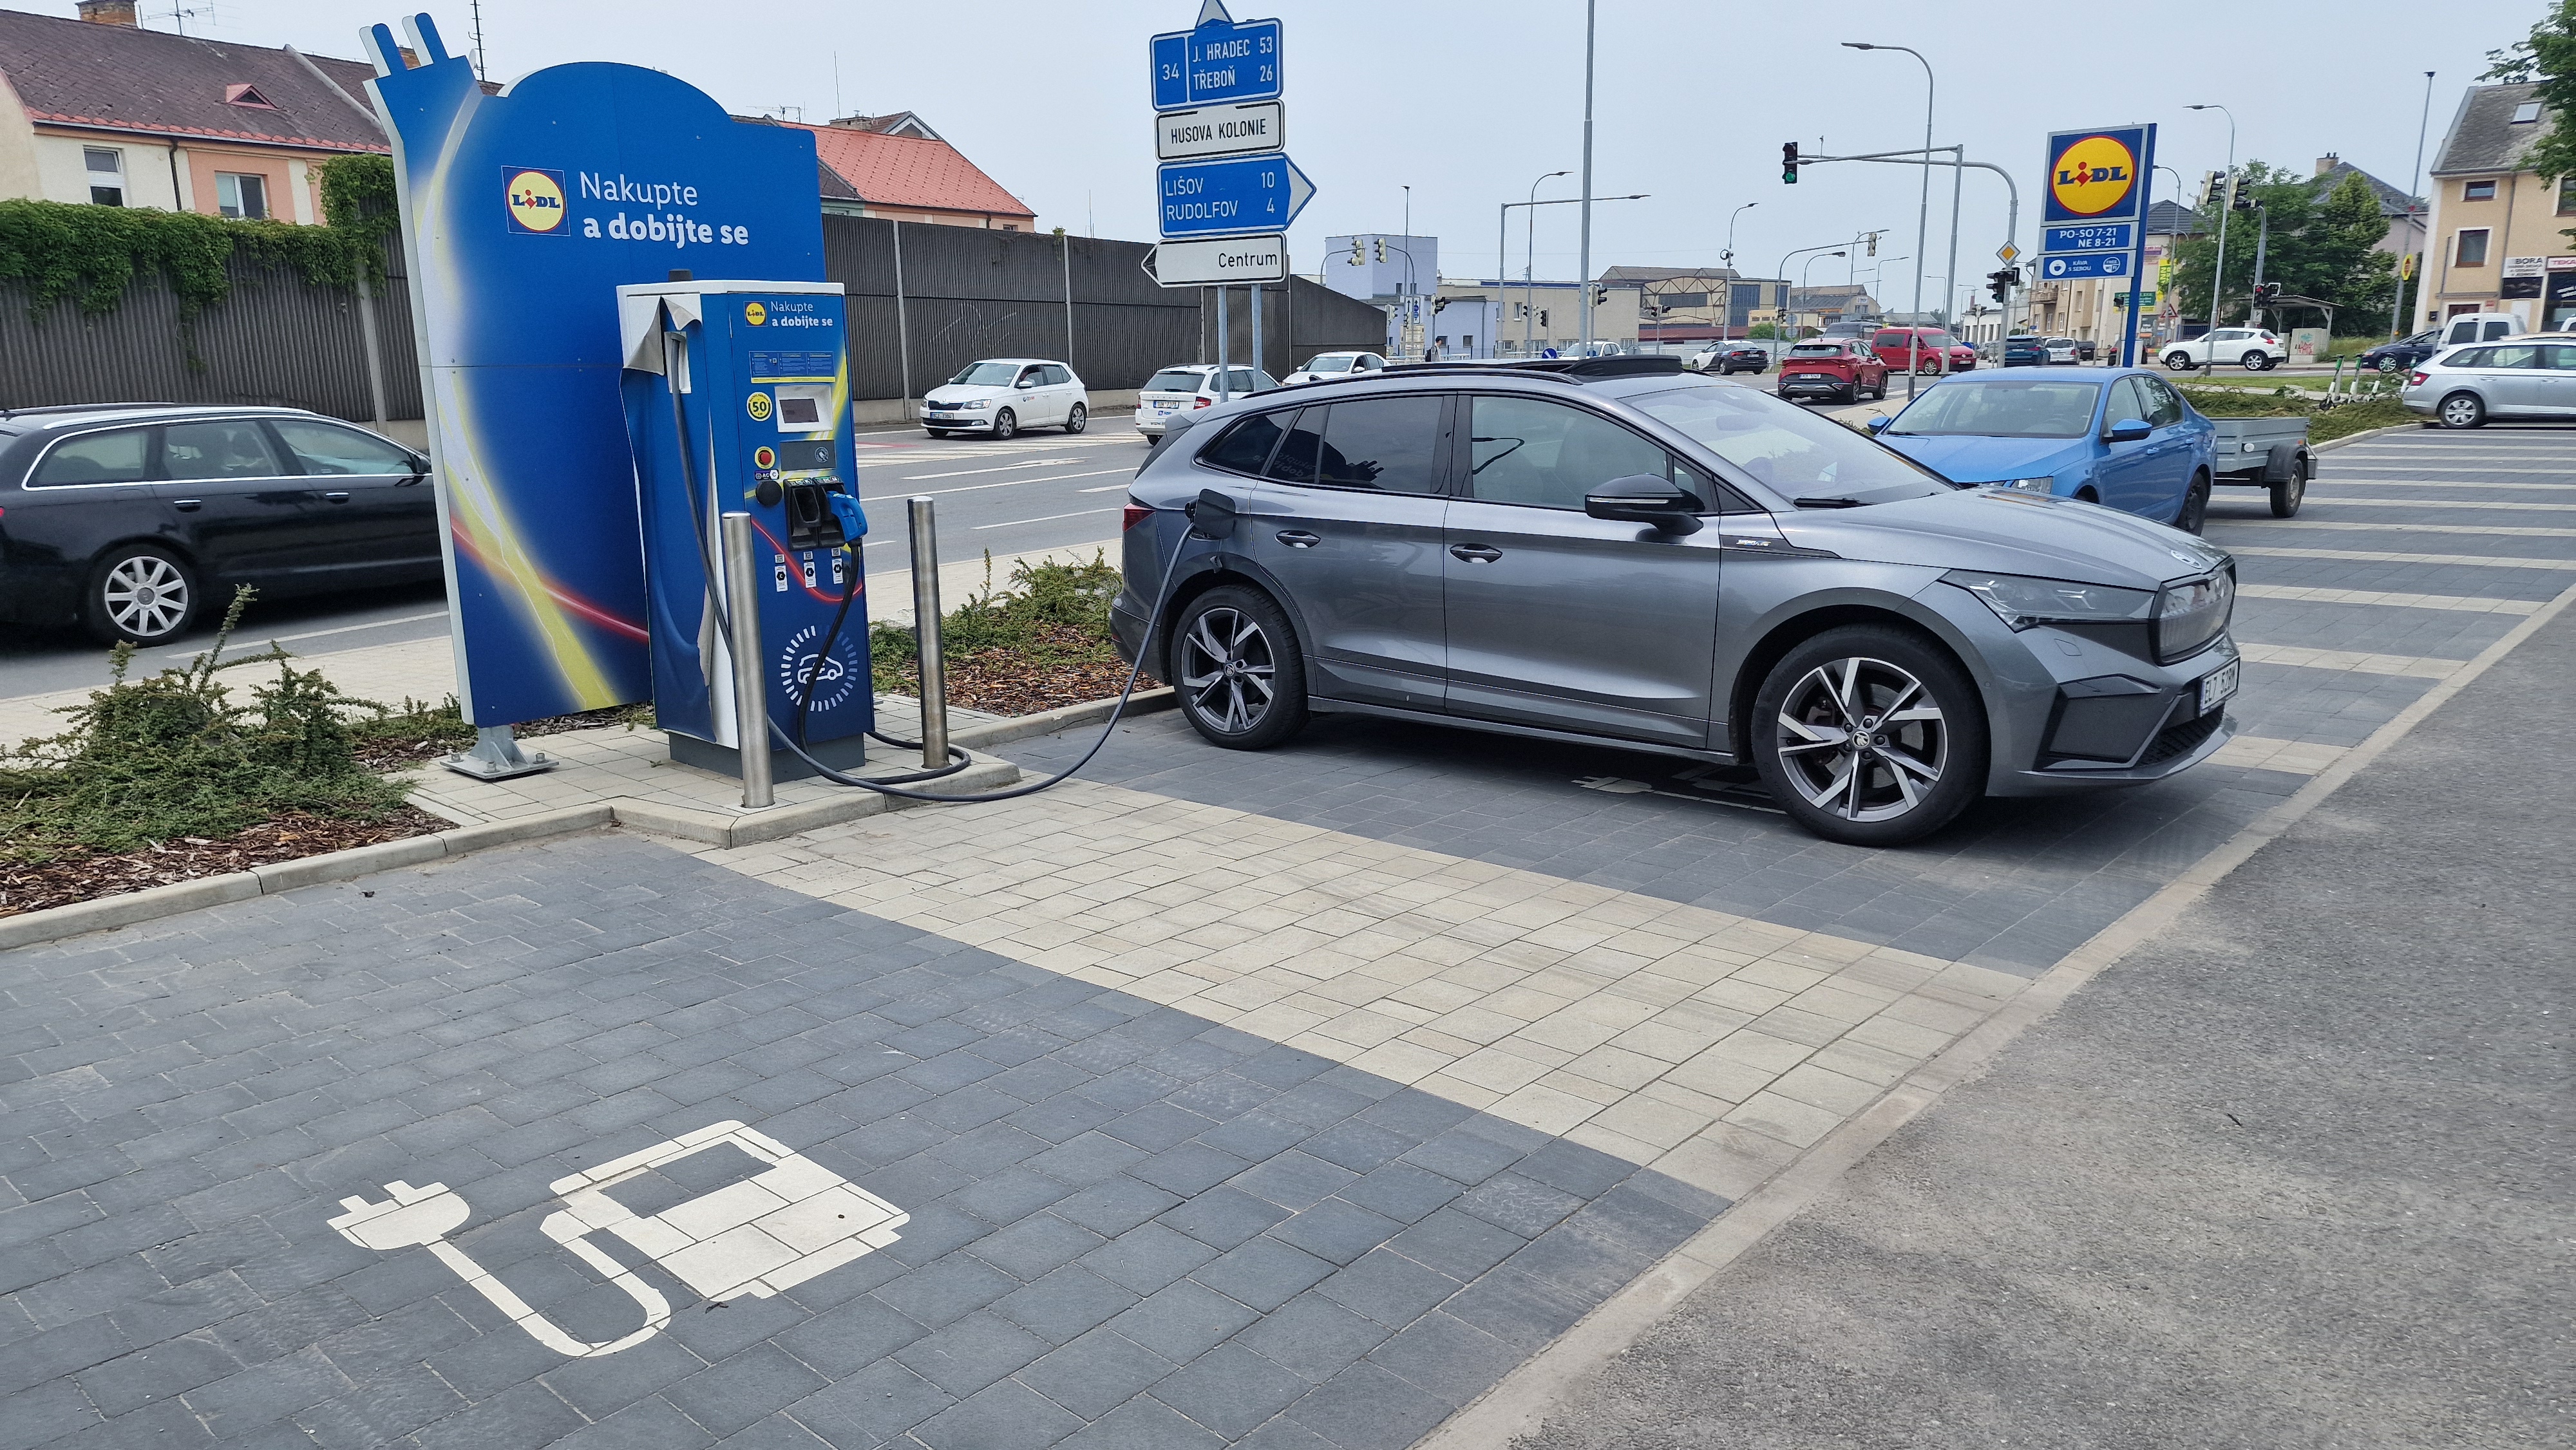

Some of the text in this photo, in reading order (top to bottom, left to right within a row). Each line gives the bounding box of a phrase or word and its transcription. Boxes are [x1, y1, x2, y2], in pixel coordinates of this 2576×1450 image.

[1192, 36, 1273, 63] J. HRADEC 53
[1162, 64, 1180, 81] 34
[1193, 64, 1273, 90] TŘEBOŇ 26
[1171, 118, 1266, 144] HUSOVA KOLONIE
[580, 171, 698, 210] Nakupte
[1165, 171, 1275, 197] LIŠOV 10
[1166, 198, 1275, 221] RUDOLFOV 4
[583, 212, 749, 249] a dobijte se
[2059, 227, 2117, 239] PO-SO 7-21
[2078, 238, 2116, 247] NE 8-21
[1218, 252, 1278, 268] Centrum
[770, 301, 813, 314] Nakupte
[781, 315, 819, 328] dobijte
[822, 317, 833, 326] se
[752, 401, 767, 412] 50
